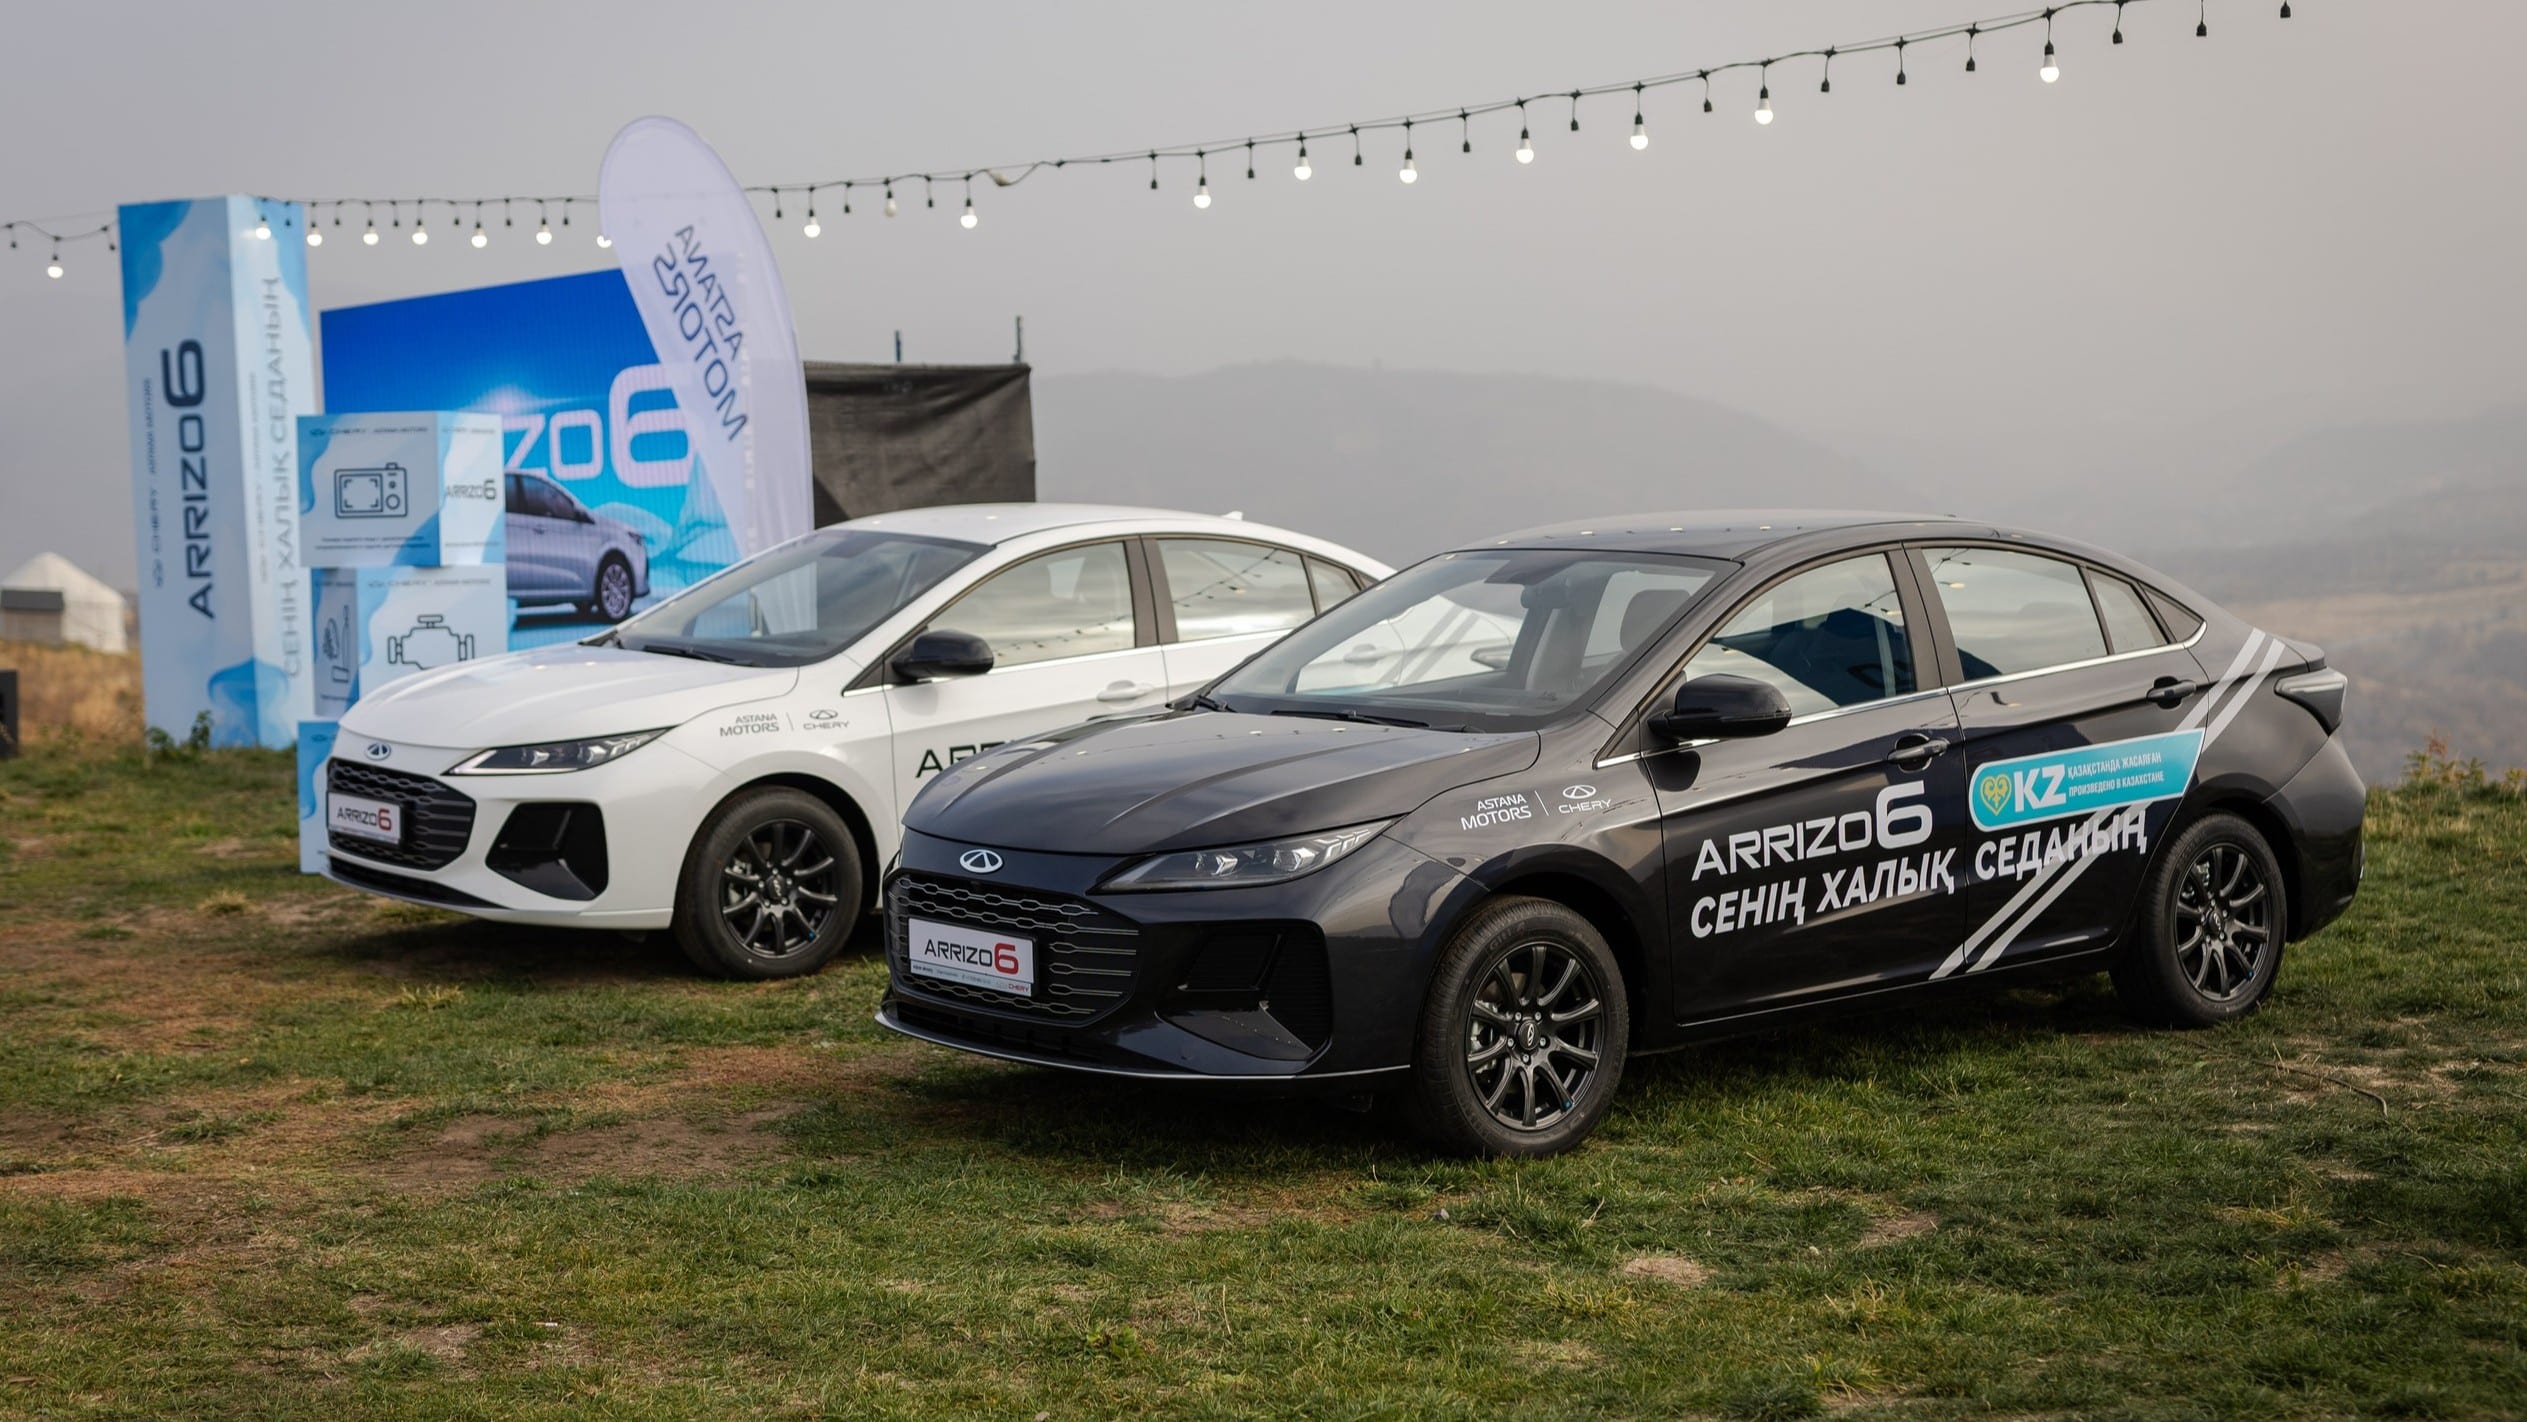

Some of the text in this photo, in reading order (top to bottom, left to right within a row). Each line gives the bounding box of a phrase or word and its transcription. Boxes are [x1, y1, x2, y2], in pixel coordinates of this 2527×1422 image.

[161, 338, 215, 621] ARRIZO6
[445, 479, 497, 501] ARRIZO6
[719, 721, 780, 737] MOTORS
[735, 713, 778, 724] ASTANA
[803, 720, 850, 730] CHERY
[2067, 752, 2162, 780] ҚАЗАҚСТАНДА ЖАСАЛҒАН
[2013, 764, 2067, 813] KZ
[2068, 772, 2165, 797] ПРОИЗВЕДЕНО В КАЗАХСТАНЕ
[1477, 793, 1527, 812] ASTANA
[1558, 798, 1613, 814] CHERY
[337, 806, 392, 831] ARRIZO6
[1460, 805, 1532, 830] MOTORS
[1691, 780, 1933, 882] ARRIZO6
[1689, 809, 2148, 940] СЕНІҢ ХАЛЫҚ СЕДАНЫҢ
[924, 938, 1020, 975] ARRIZO6
